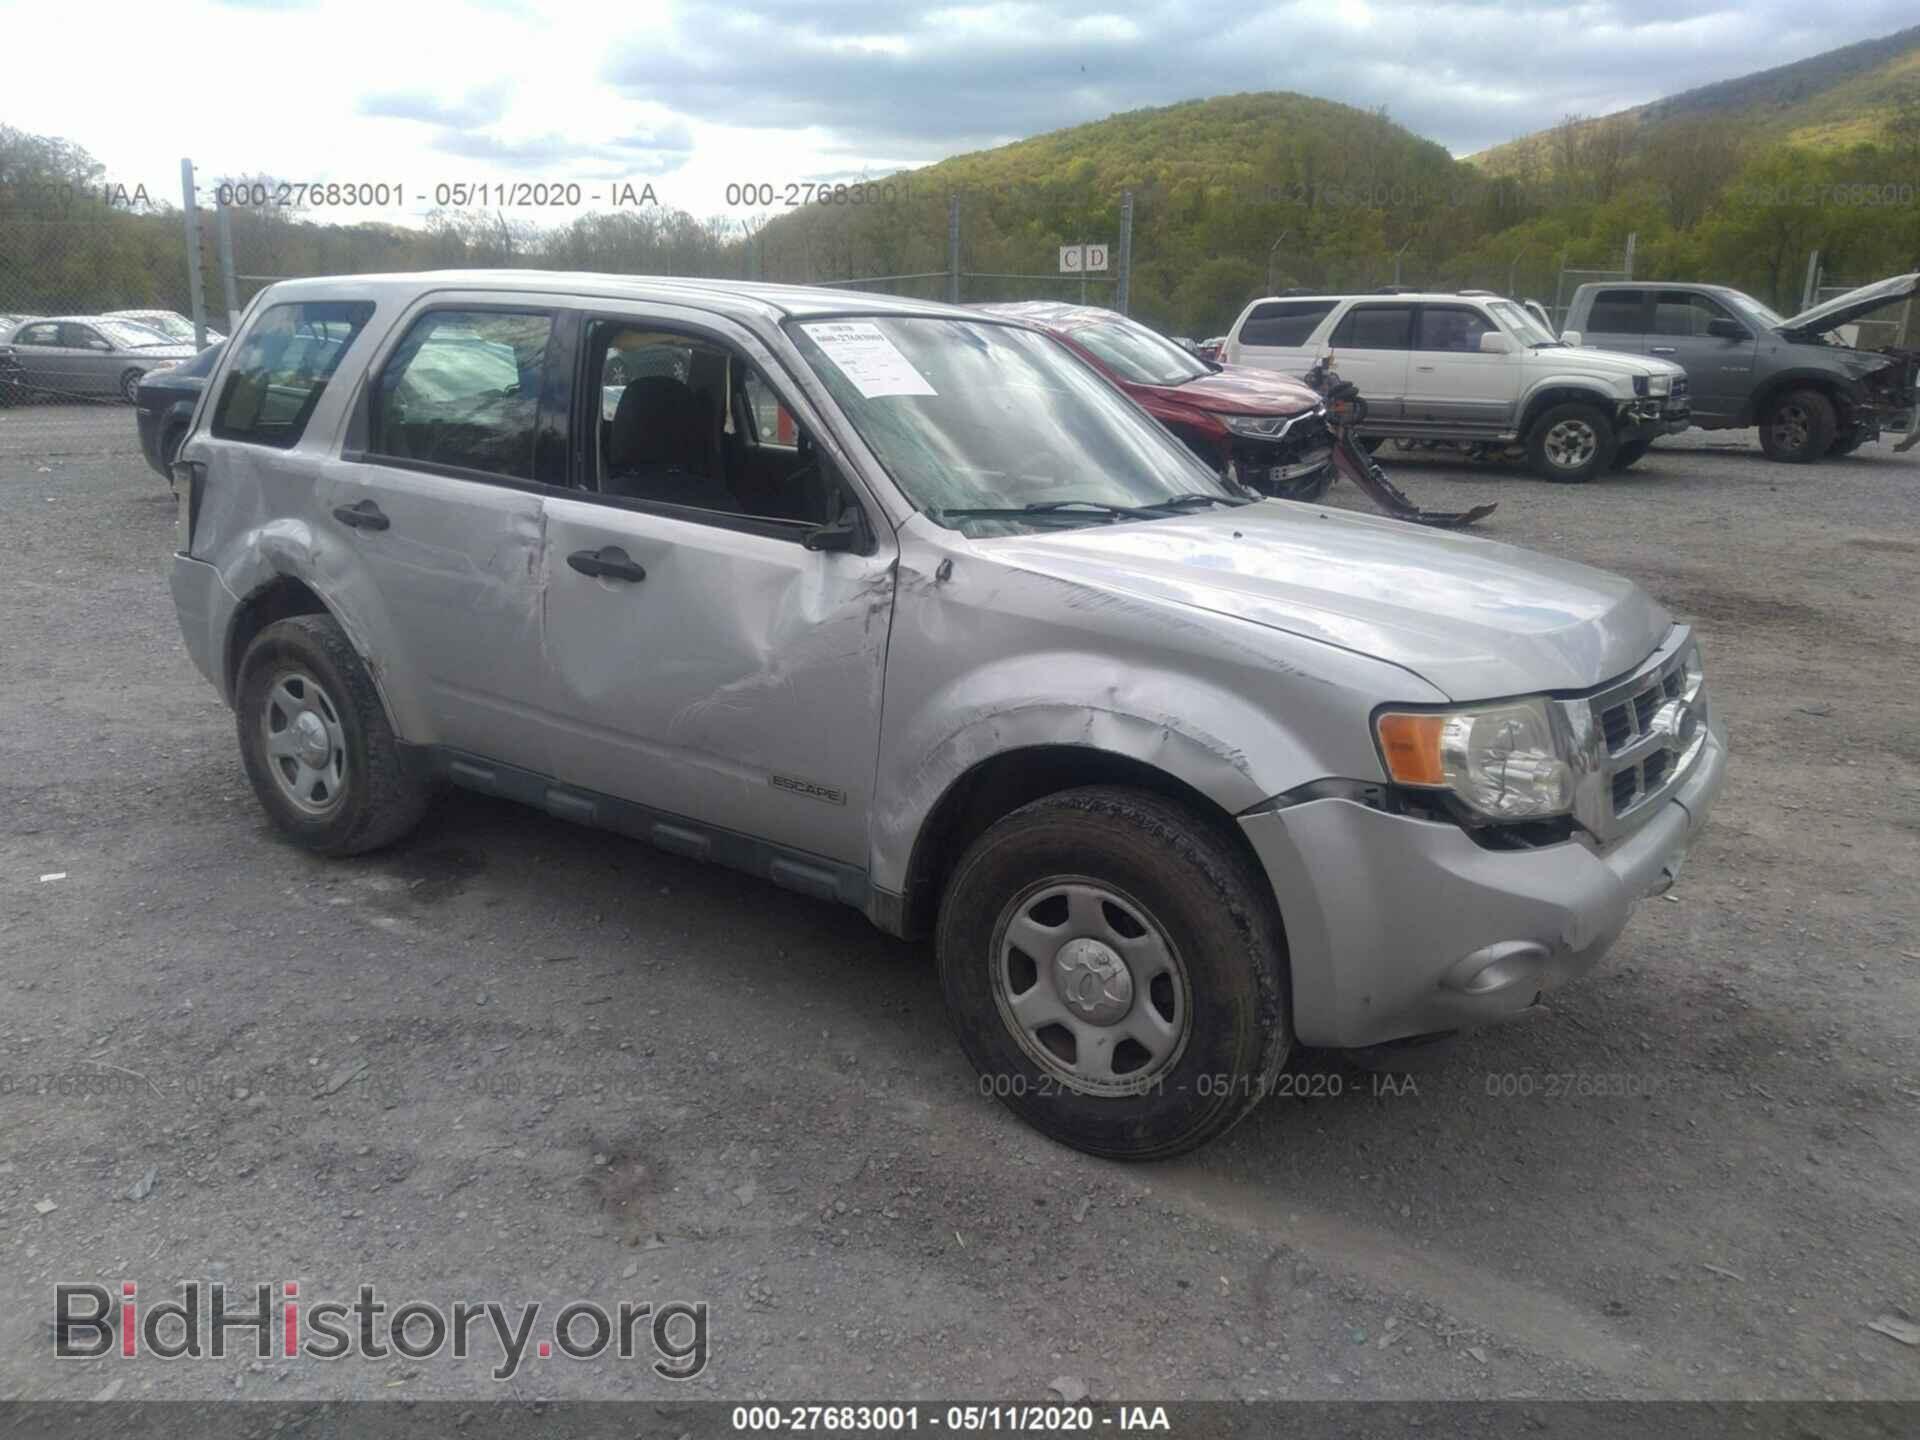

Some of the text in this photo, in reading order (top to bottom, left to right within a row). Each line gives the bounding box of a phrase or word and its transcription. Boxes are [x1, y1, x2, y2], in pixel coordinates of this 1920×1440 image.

[1064, 249, 1078, 268] C
[1090, 248, 1104, 266] D
[772, 774, 842, 802] ESCAPE
